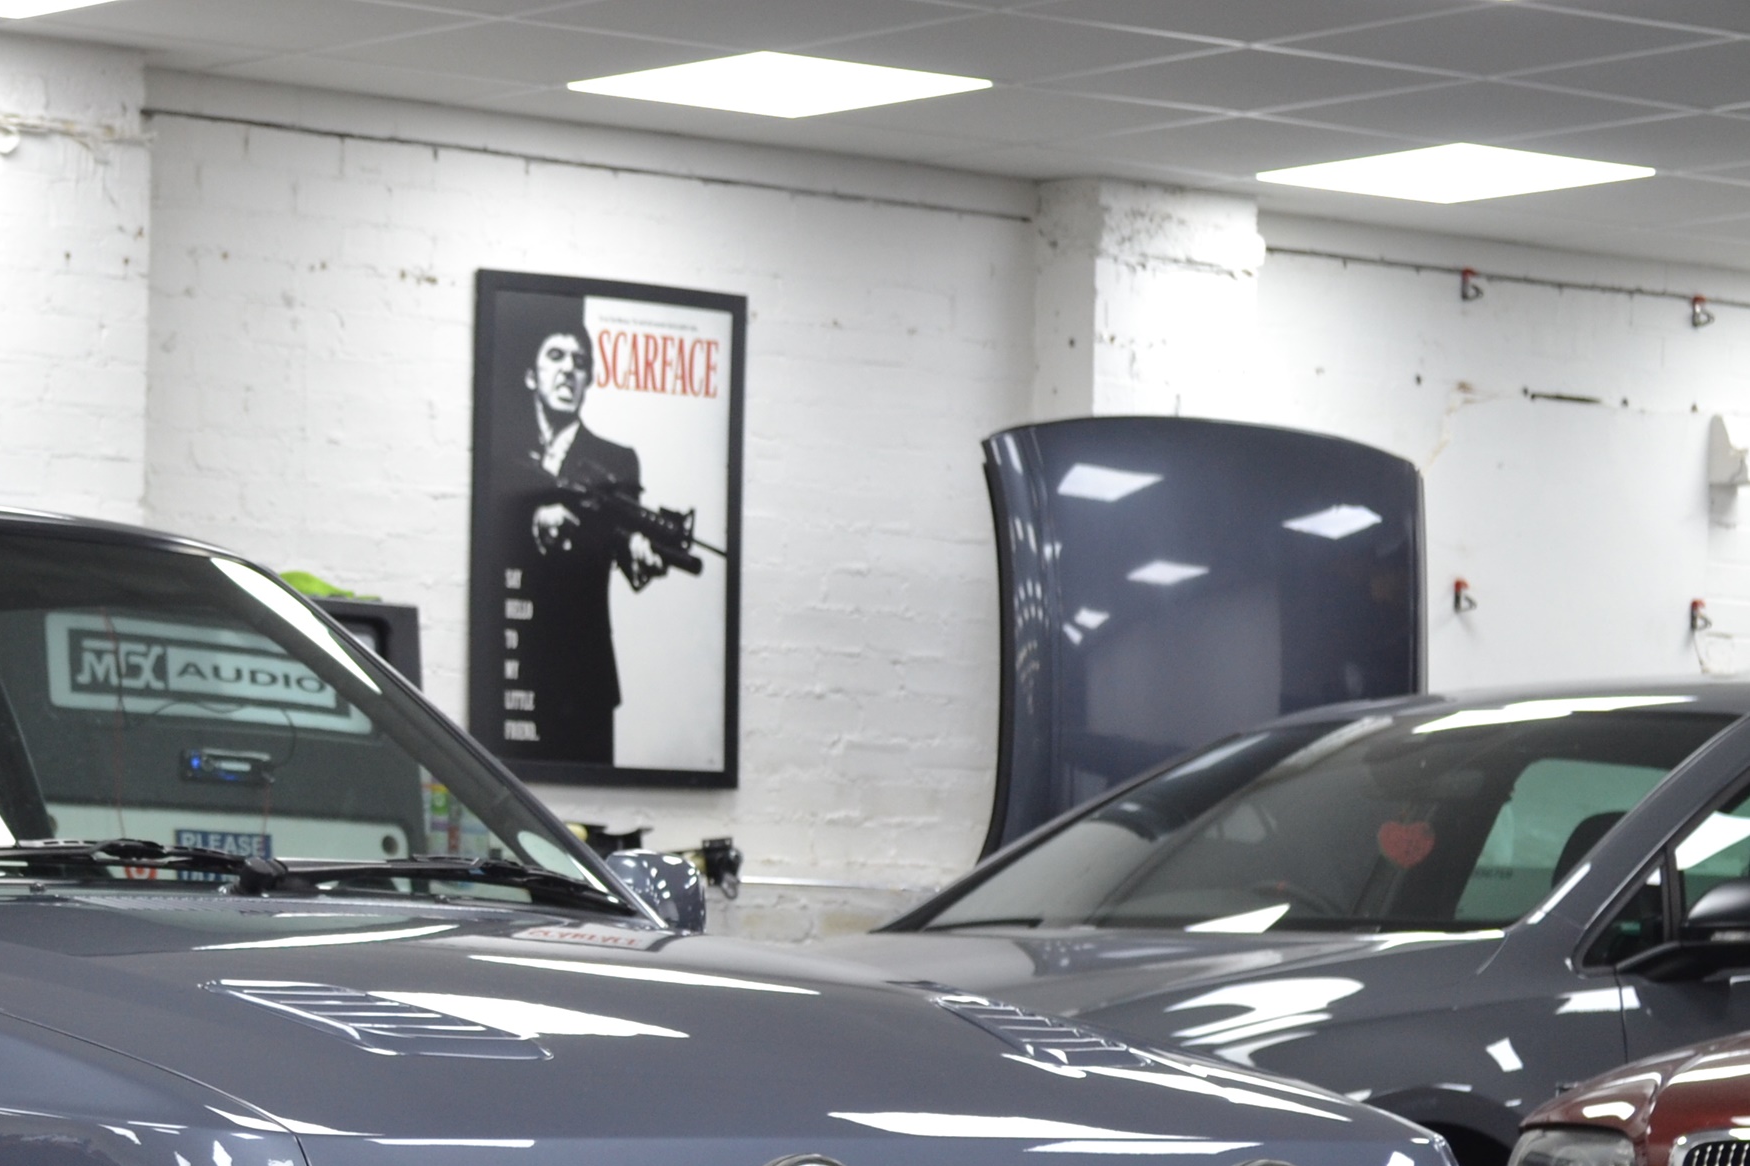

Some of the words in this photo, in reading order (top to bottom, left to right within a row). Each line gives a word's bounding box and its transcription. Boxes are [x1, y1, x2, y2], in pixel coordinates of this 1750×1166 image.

[596, 329, 719, 398] SCARFACE
[176, 661, 328, 694] AUDIO
[180, 831, 264, 857] PLEASE
